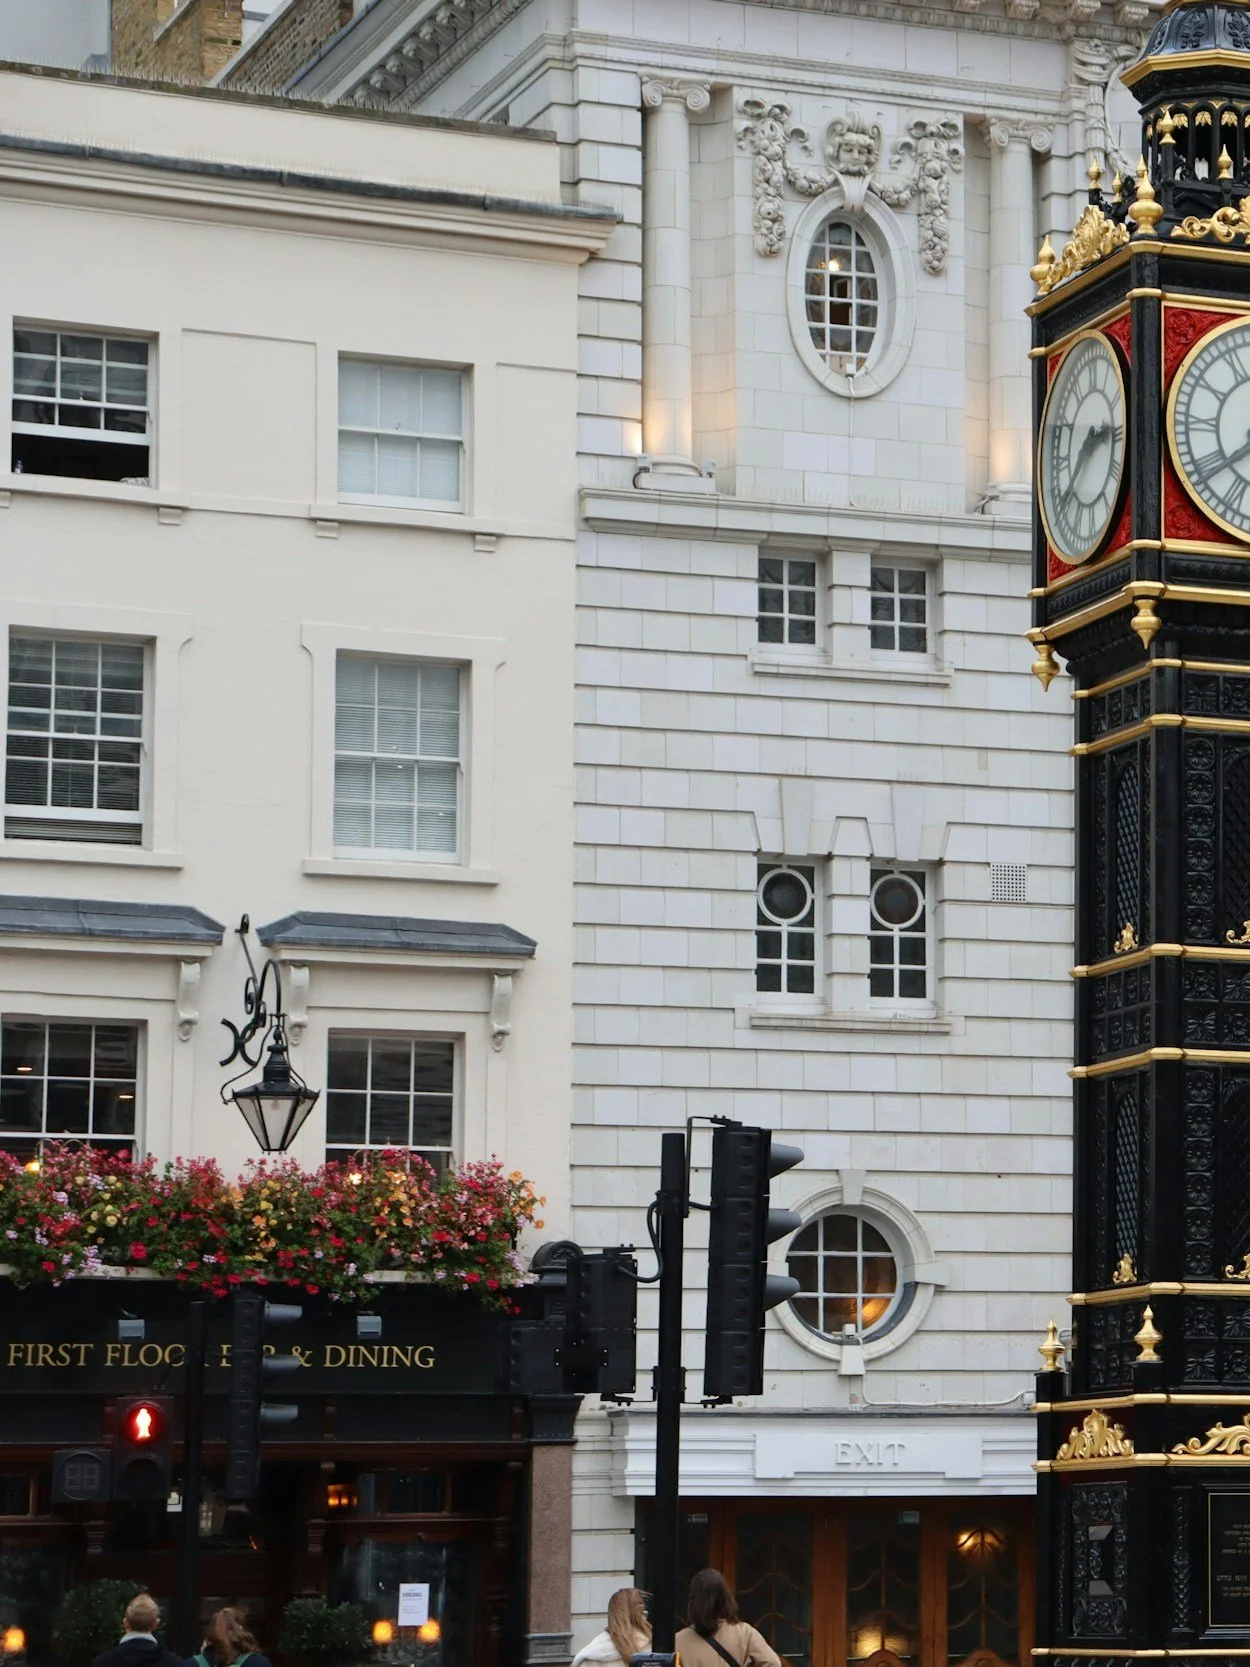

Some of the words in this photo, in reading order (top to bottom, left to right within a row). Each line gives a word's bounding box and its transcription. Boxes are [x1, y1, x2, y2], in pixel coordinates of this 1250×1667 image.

[7, 1343, 94, 1367] FIRST
[105, 1344, 210, 1367] FLOO
[323, 1345, 436, 1368] DINING
[835, 1442, 906, 1465] EXIT
